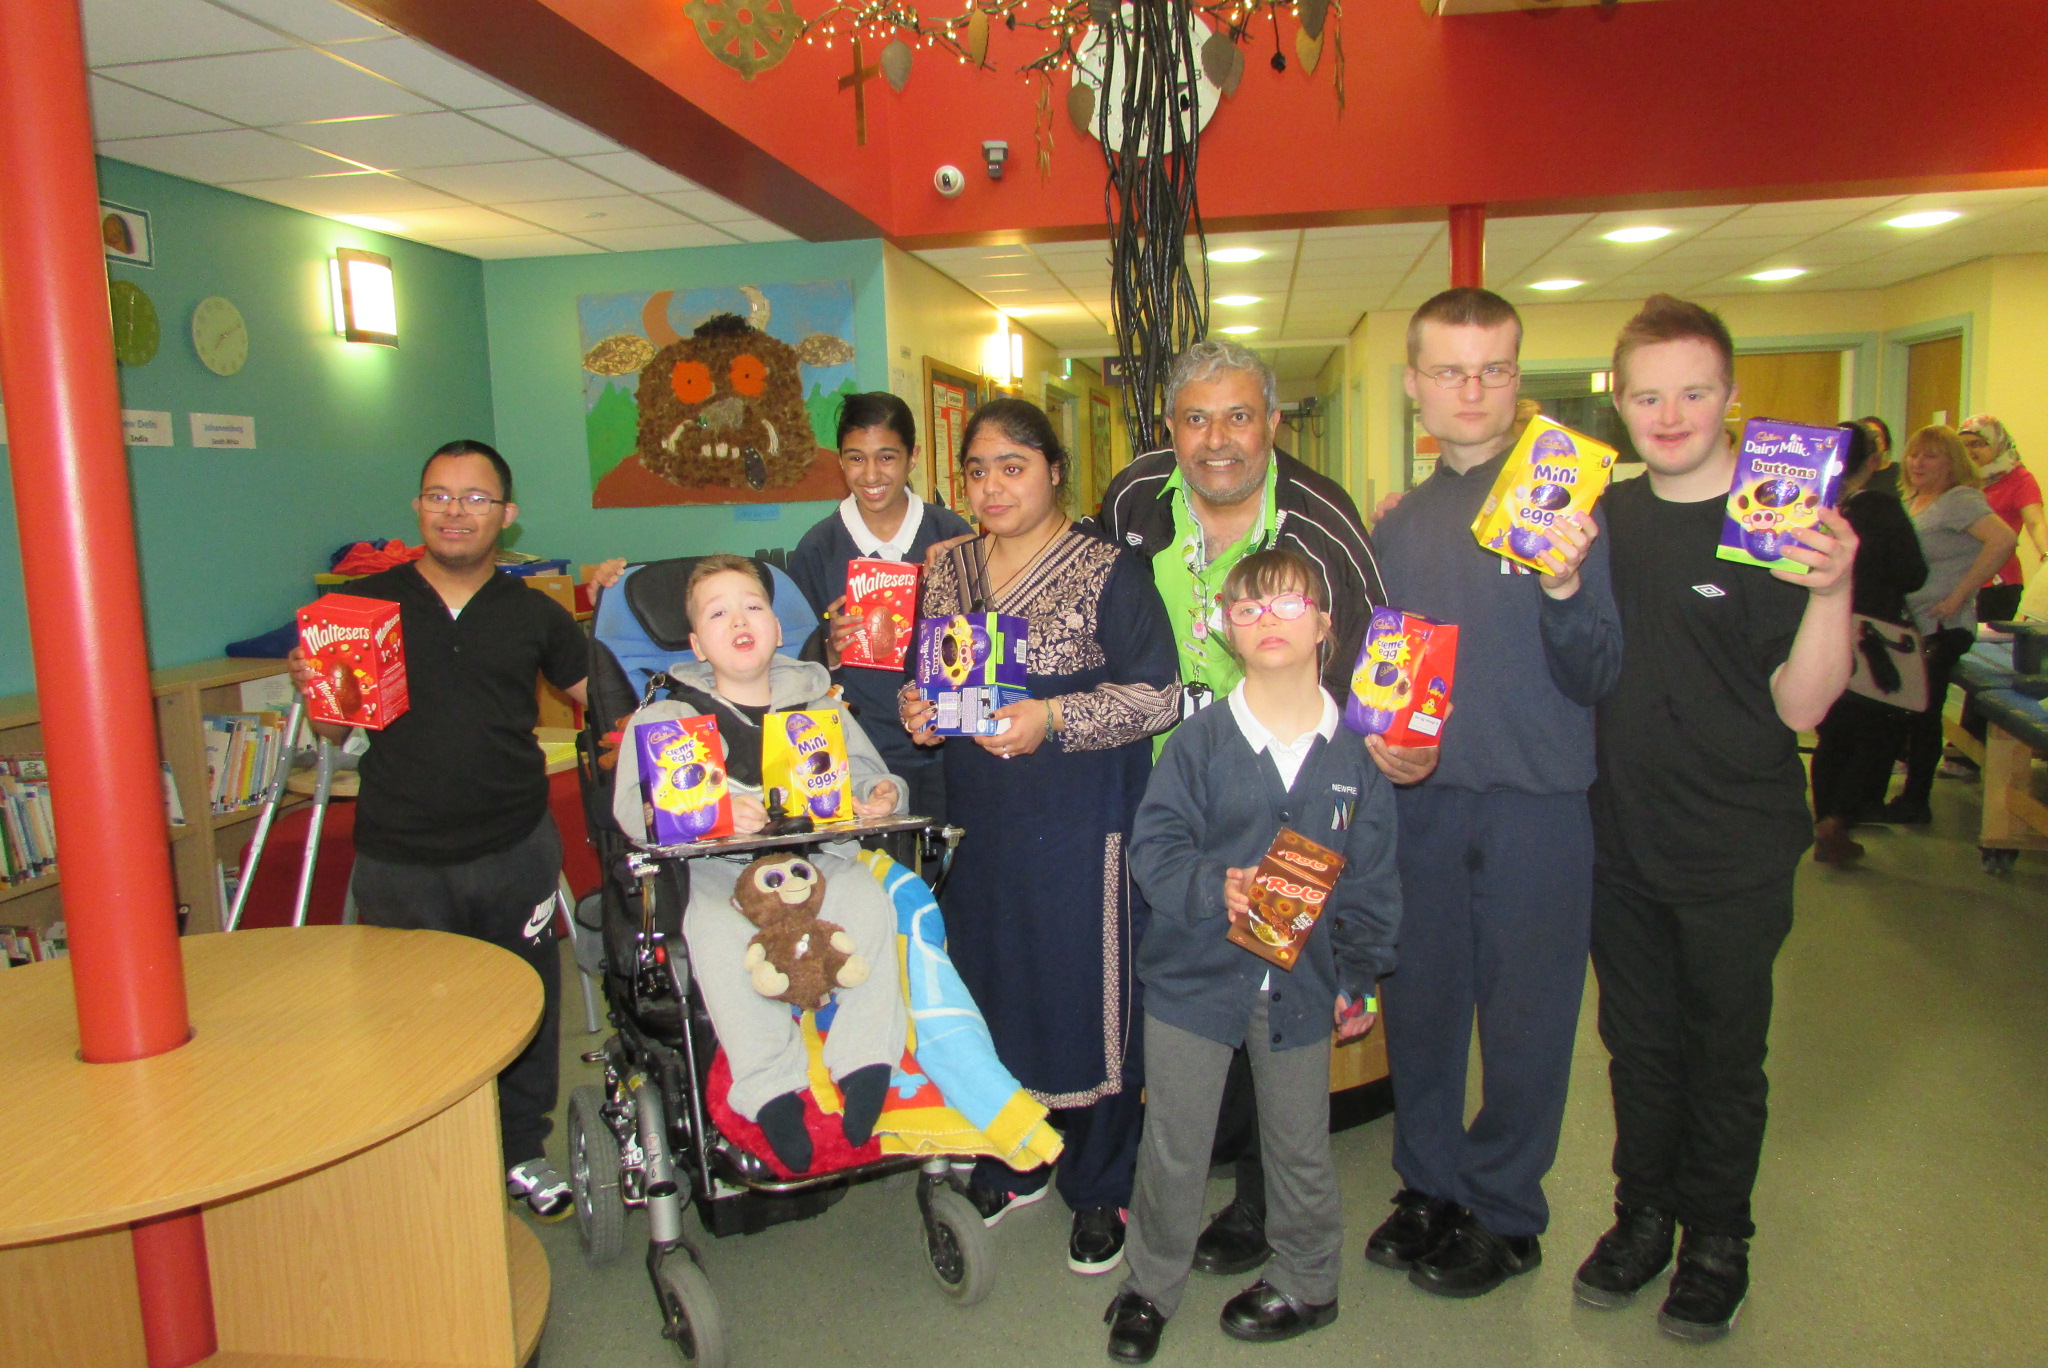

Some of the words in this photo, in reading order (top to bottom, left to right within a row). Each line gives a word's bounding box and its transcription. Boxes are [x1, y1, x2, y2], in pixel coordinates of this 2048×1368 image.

[130, 434, 148, 443] India
[1744, 440, 1779, 457] Dairy
[1779, 441, 1810, 457] Milk
[1534, 464, 1577, 485] Mini
[1751, 458, 1816, 480] buttons
[1521, 507, 1563, 526] egg
[849, 571, 915, 603] Maltesers
[302, 623, 370, 656] Maltesers
[1377, 639, 1403, 649] creme
[931, 627, 941, 675] buttons
[1378, 648, 1398, 661] egg
[924, 659, 932, 684] Dairy
[316, 680, 340, 715] Maltesers
[665, 738, 695, 756] creme
[797, 732, 828, 756] Mini
[671, 749, 695, 764] egg
[807, 771, 837, 789] eggs
[1284, 851, 1329, 872] Rolo
[1265, 876, 1326, 904] Rolo
